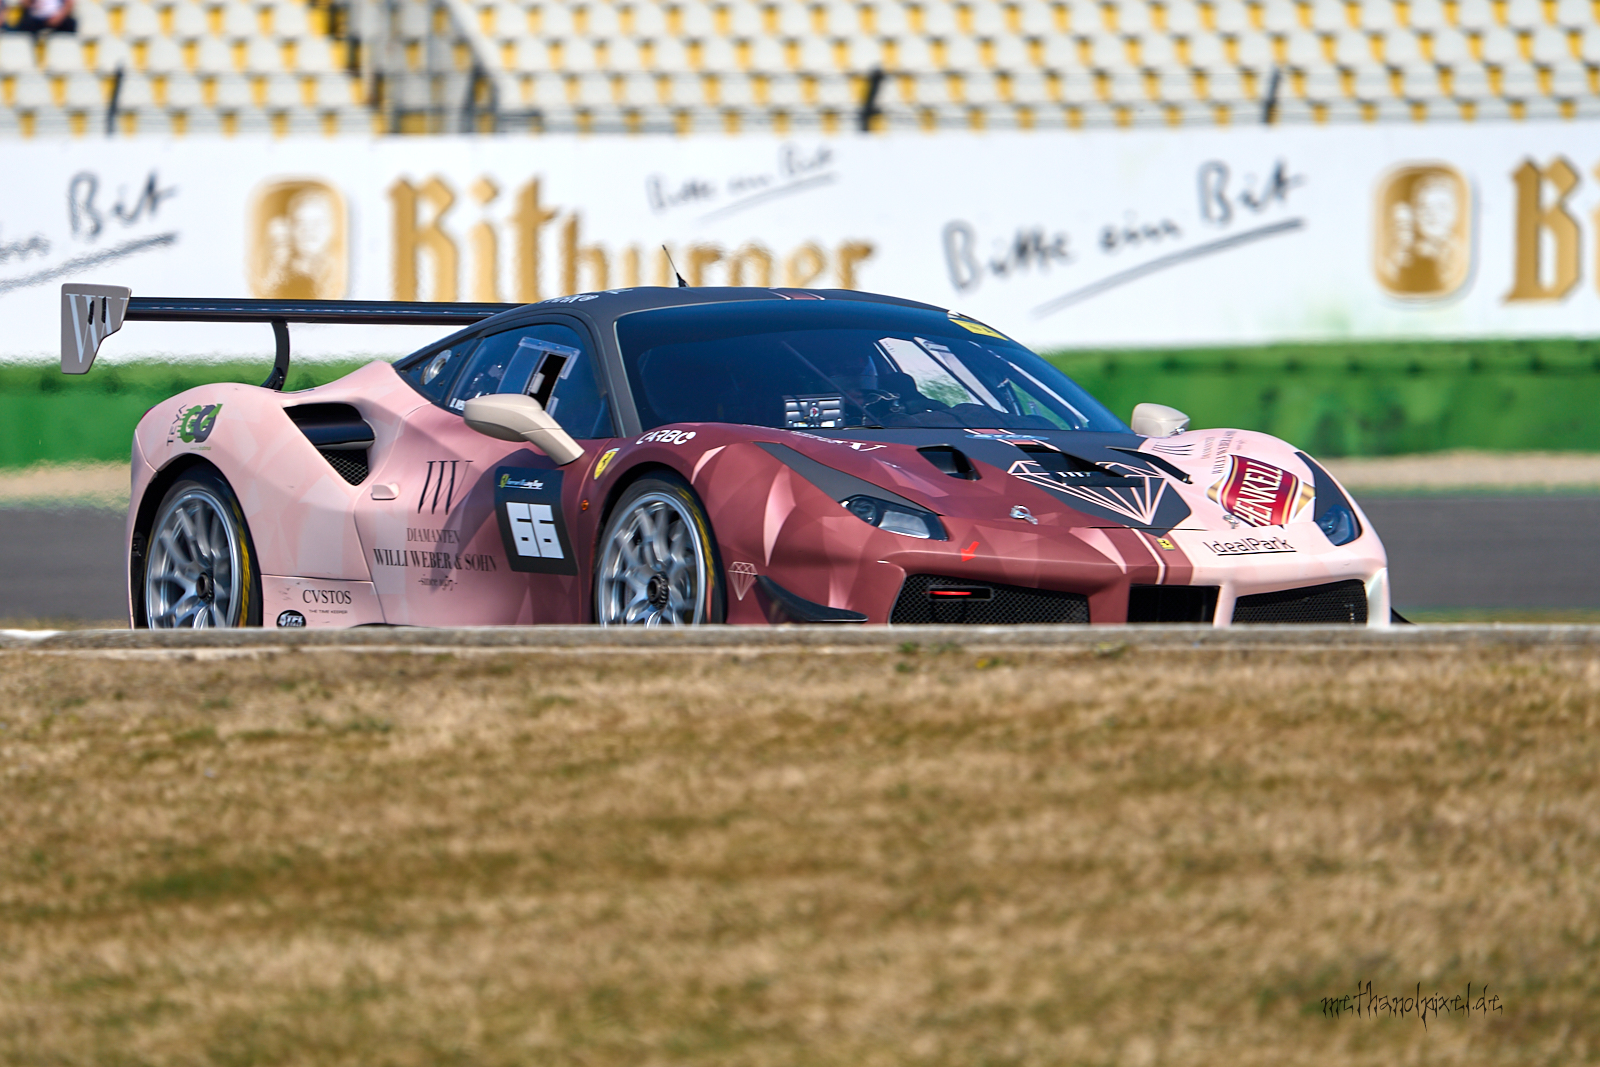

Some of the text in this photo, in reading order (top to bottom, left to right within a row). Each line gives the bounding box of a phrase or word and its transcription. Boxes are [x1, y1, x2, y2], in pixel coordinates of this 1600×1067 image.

[67, 169, 177, 241] Bit
[943, 159, 1305, 296] Bitte ein Bit
[1233, 461, 1284, 528] HENKELL
[406, 527, 460, 544] DIAMANTEN
[506, 502, 564, 559] 66
[1203, 537, 1294, 554] IdealPark
[373, 548, 497, 572] WILLI WEBER & SOHN
[302, 589, 352, 605] CVSTOS
